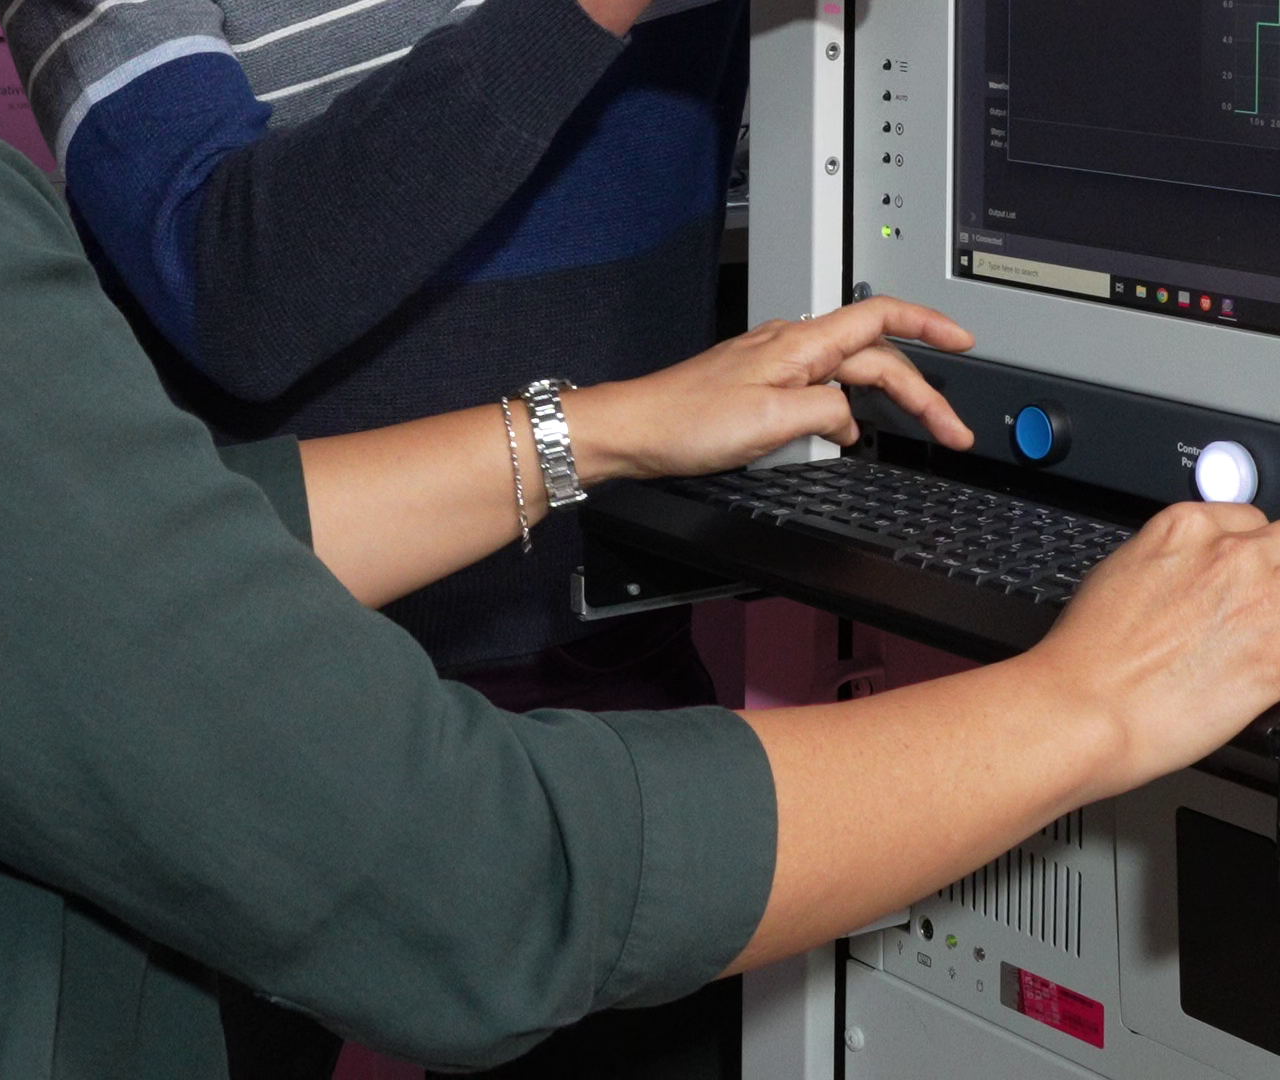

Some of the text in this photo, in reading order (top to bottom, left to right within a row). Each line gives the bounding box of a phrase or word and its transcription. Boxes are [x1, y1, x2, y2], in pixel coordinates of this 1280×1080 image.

[988, 208, 1016, 219] Output List
[976, 235, 1003, 246] Connected
[988, 262, 1000, 271] Type
[1001, 264, 1014, 273] here
[1021, 267, 1039, 276] search
[1177, 442, 1203, 456] Contr
